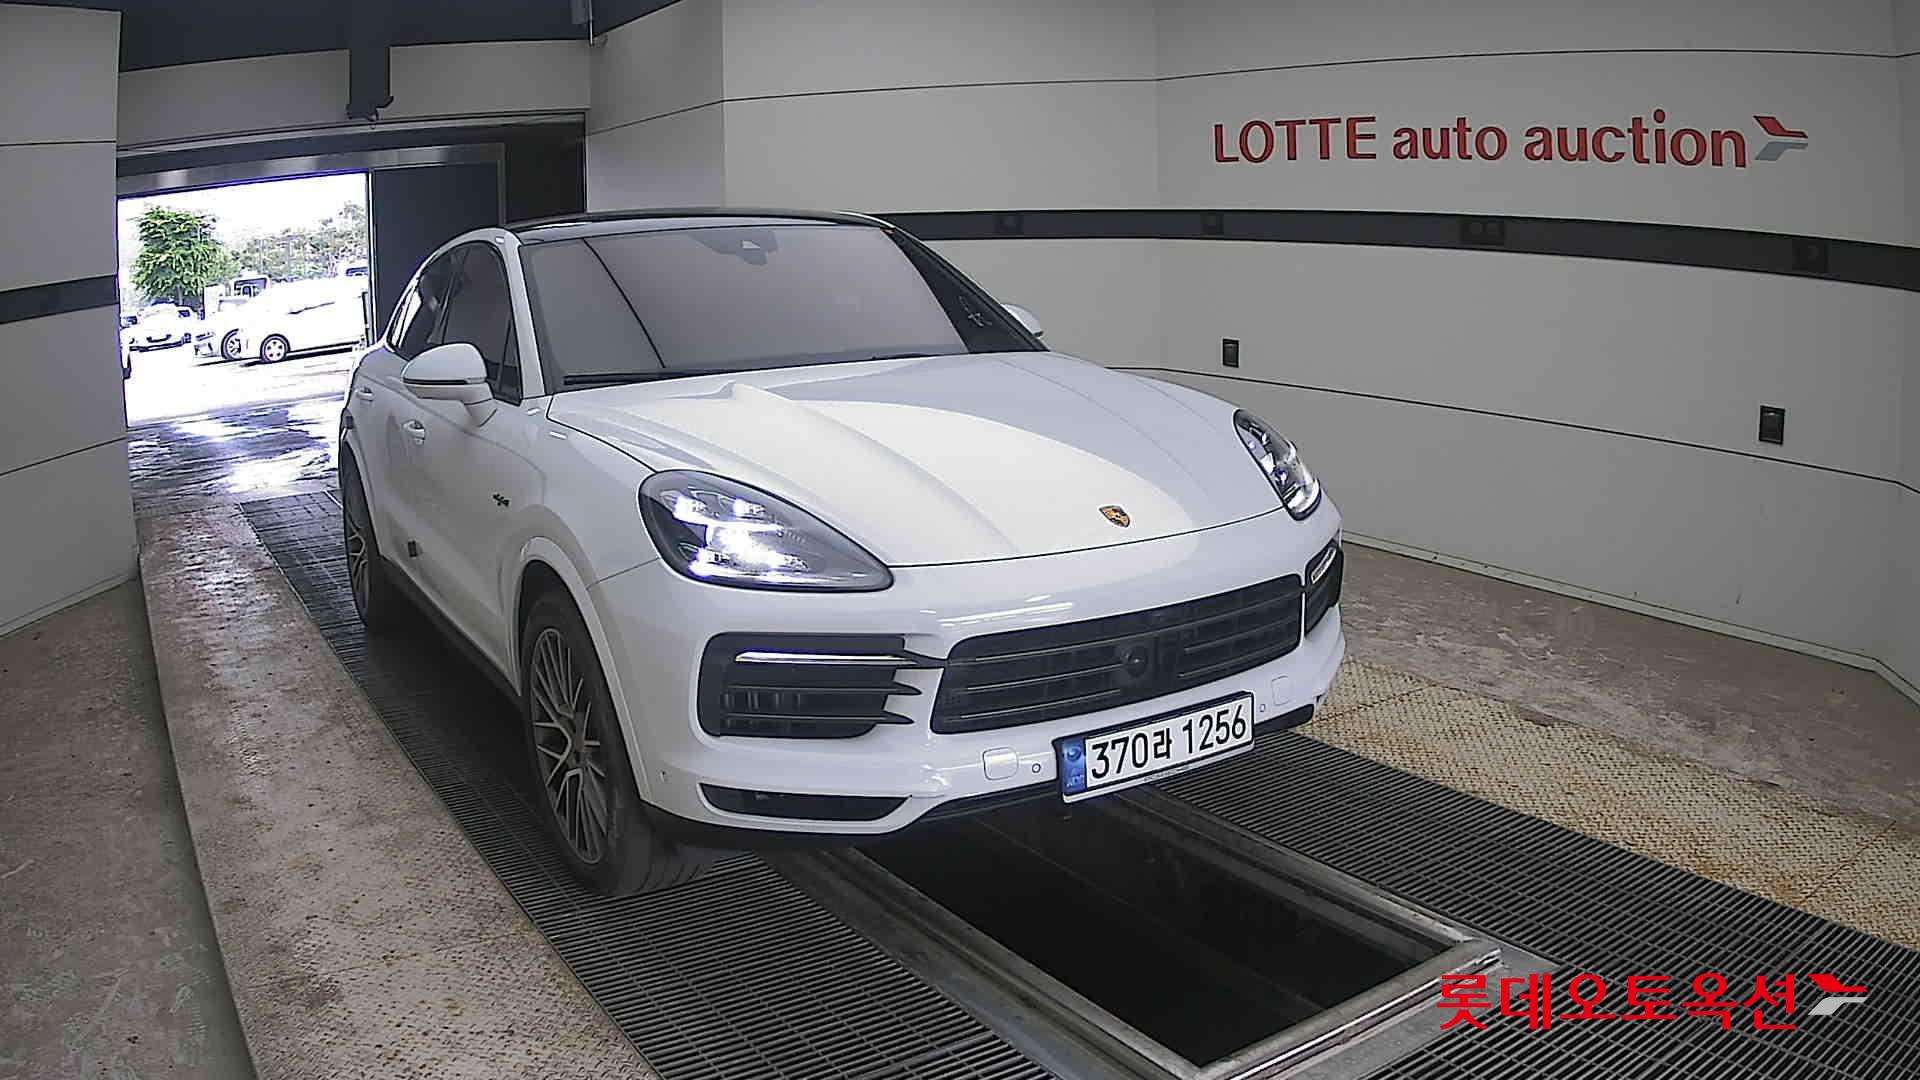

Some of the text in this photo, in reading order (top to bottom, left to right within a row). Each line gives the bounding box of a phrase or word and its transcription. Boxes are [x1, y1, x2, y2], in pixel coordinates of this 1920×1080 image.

[1213, 108, 1747, 168] LOTTE auto auction
[1091, 704, 1247, 779] 370라 1256
